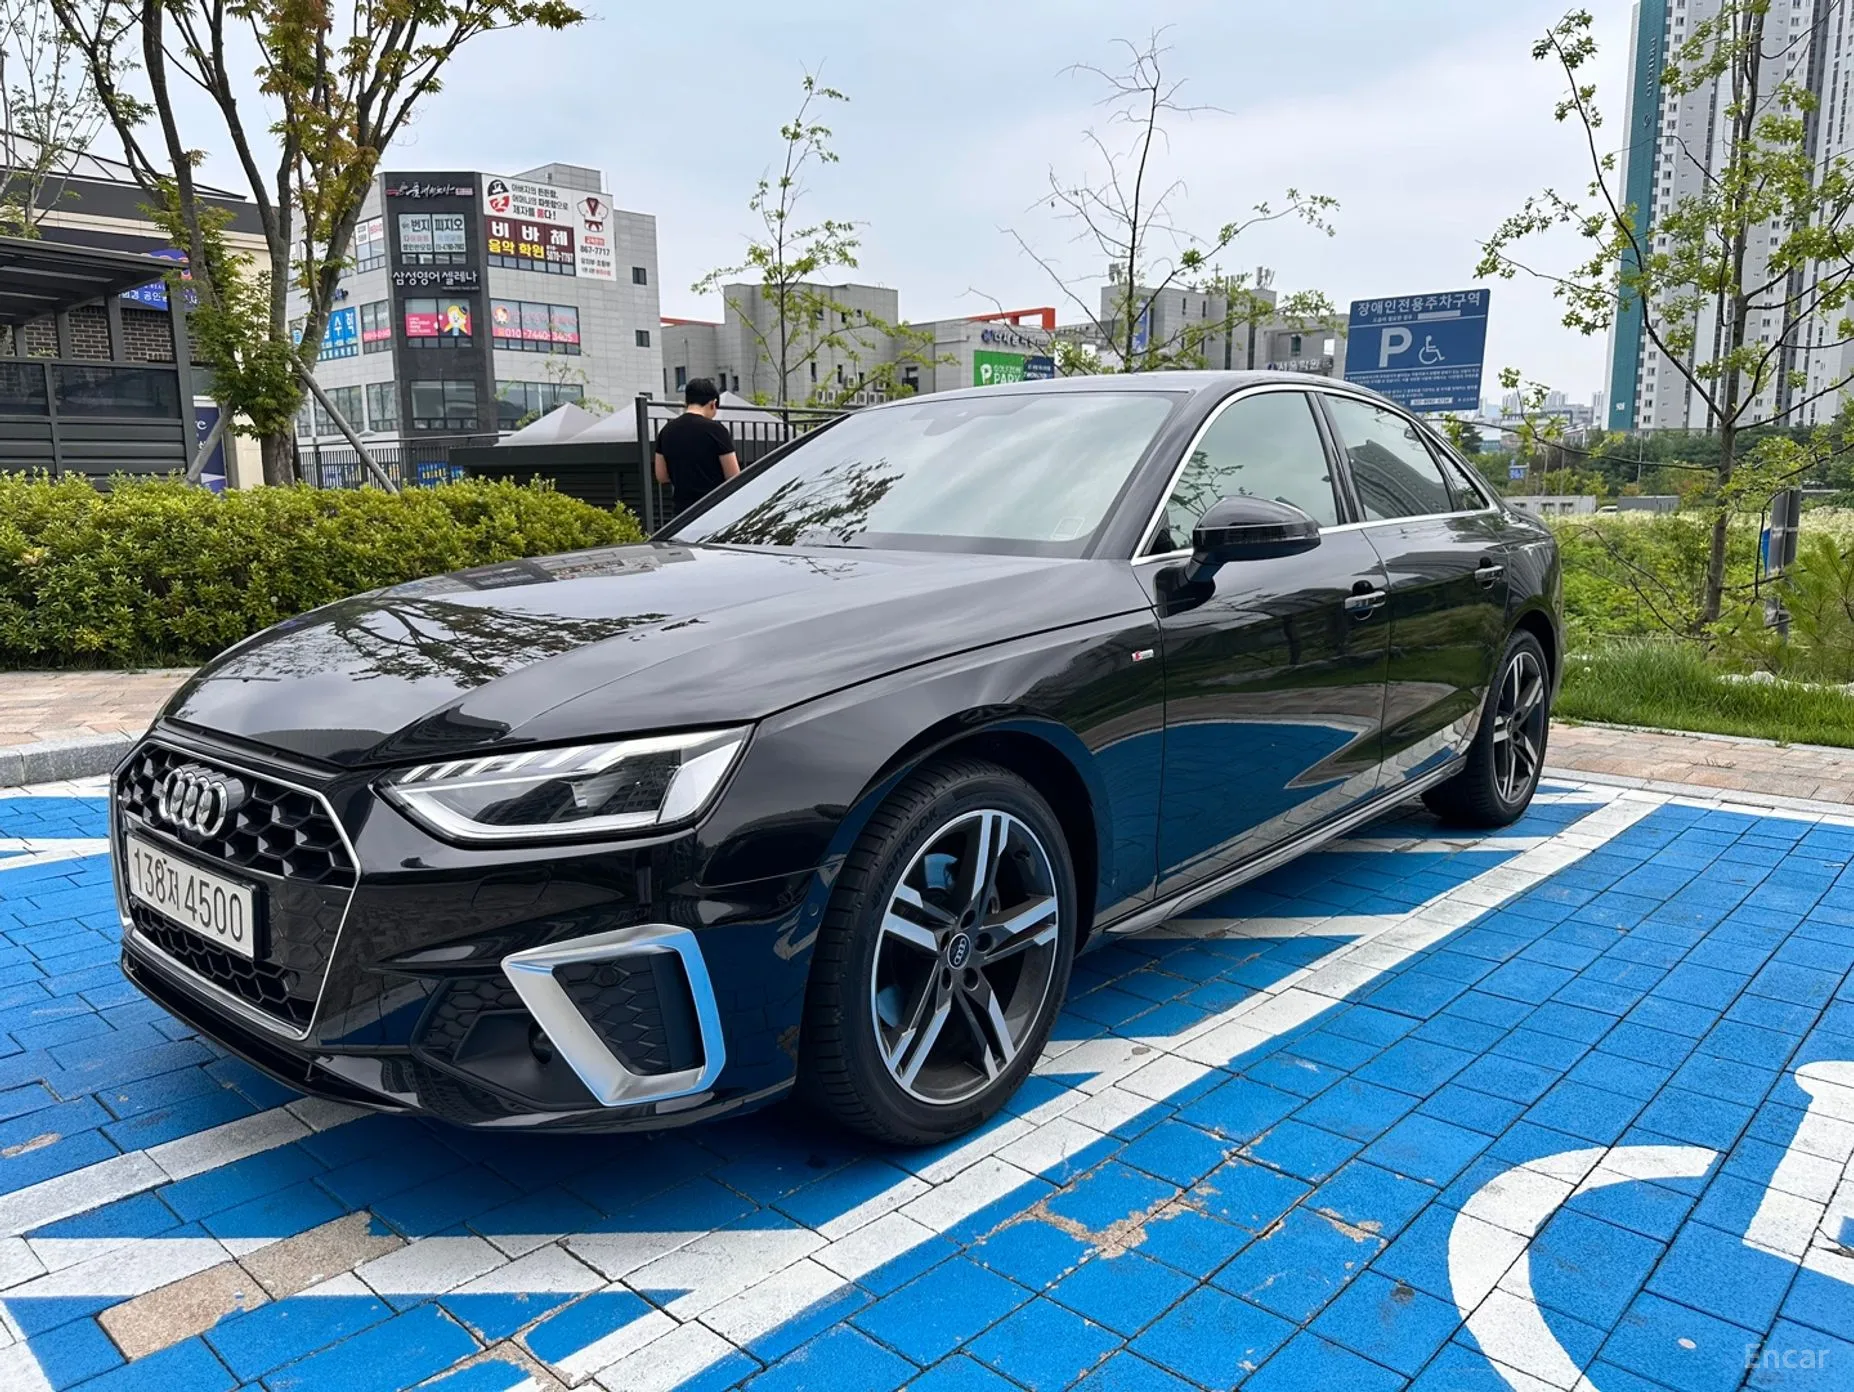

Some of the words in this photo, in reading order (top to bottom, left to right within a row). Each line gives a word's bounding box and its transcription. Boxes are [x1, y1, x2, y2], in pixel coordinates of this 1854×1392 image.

[411, 218, 430, 232] 번지
[434, 217, 464, 232] 피지오
[488, 238, 515, 255] 음악
[518, 242, 545, 259] 학원
[393, 271, 440, 286] 삼성영어
[442, 270, 477, 286] 셀레나
[1358, 291, 1481, 317] 장애인전용주차구역
[1378, 326, 1413, 368] P
[184, 874, 243, 943] 4500
